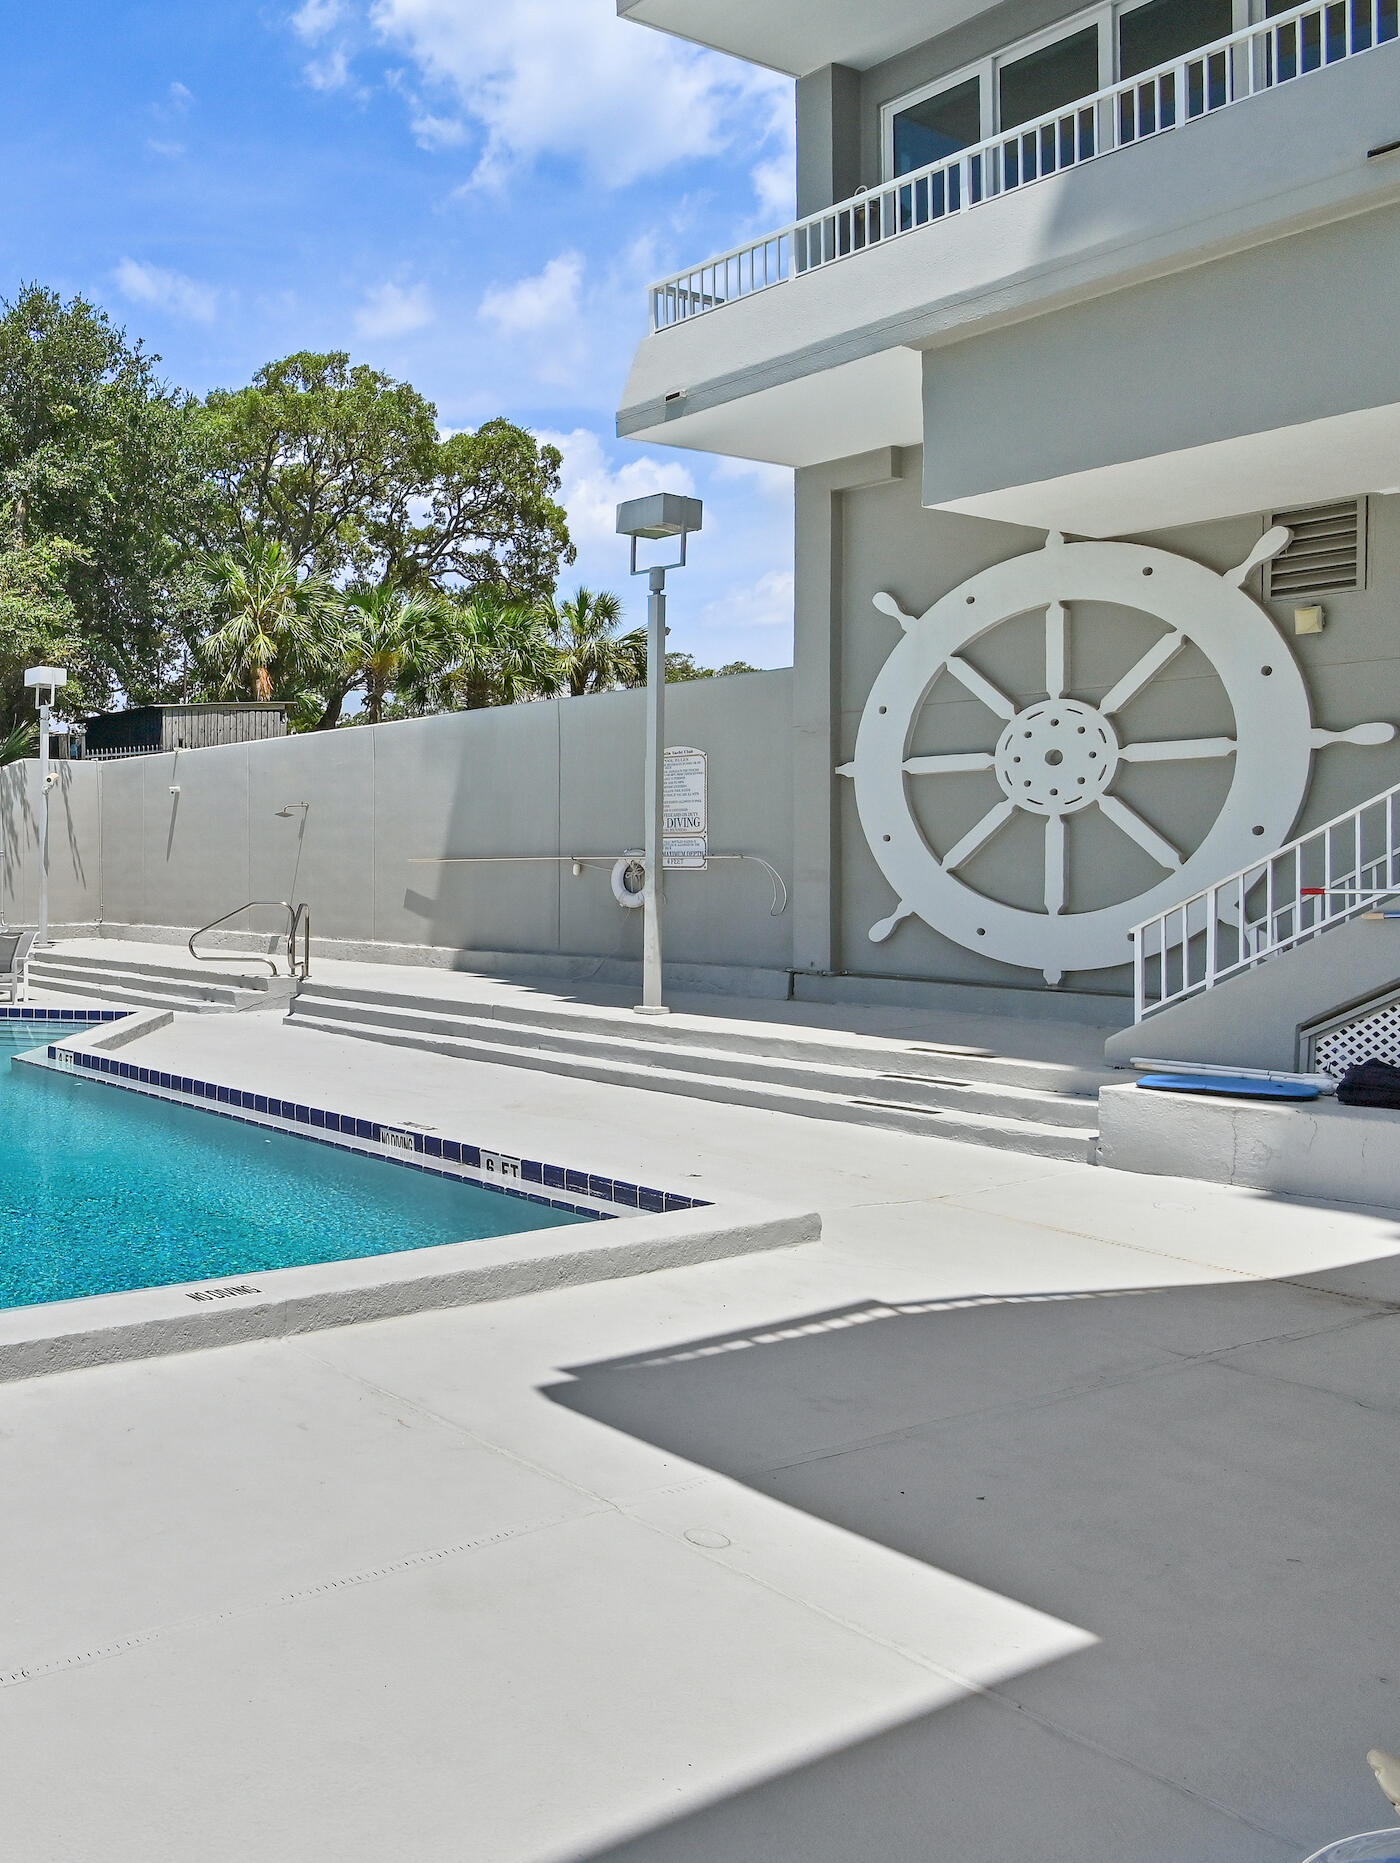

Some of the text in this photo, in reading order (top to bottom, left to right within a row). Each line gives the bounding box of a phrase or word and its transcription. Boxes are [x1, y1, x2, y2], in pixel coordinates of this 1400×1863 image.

[666, 816, 701, 828] DIVING
[65, 1054, 73, 1064] FT
[381, 1132, 413, 1151] NO DIVING
[485, 1158, 519, 1178] 6 FT
[185, 1285, 262, 1302] NO DIVING
